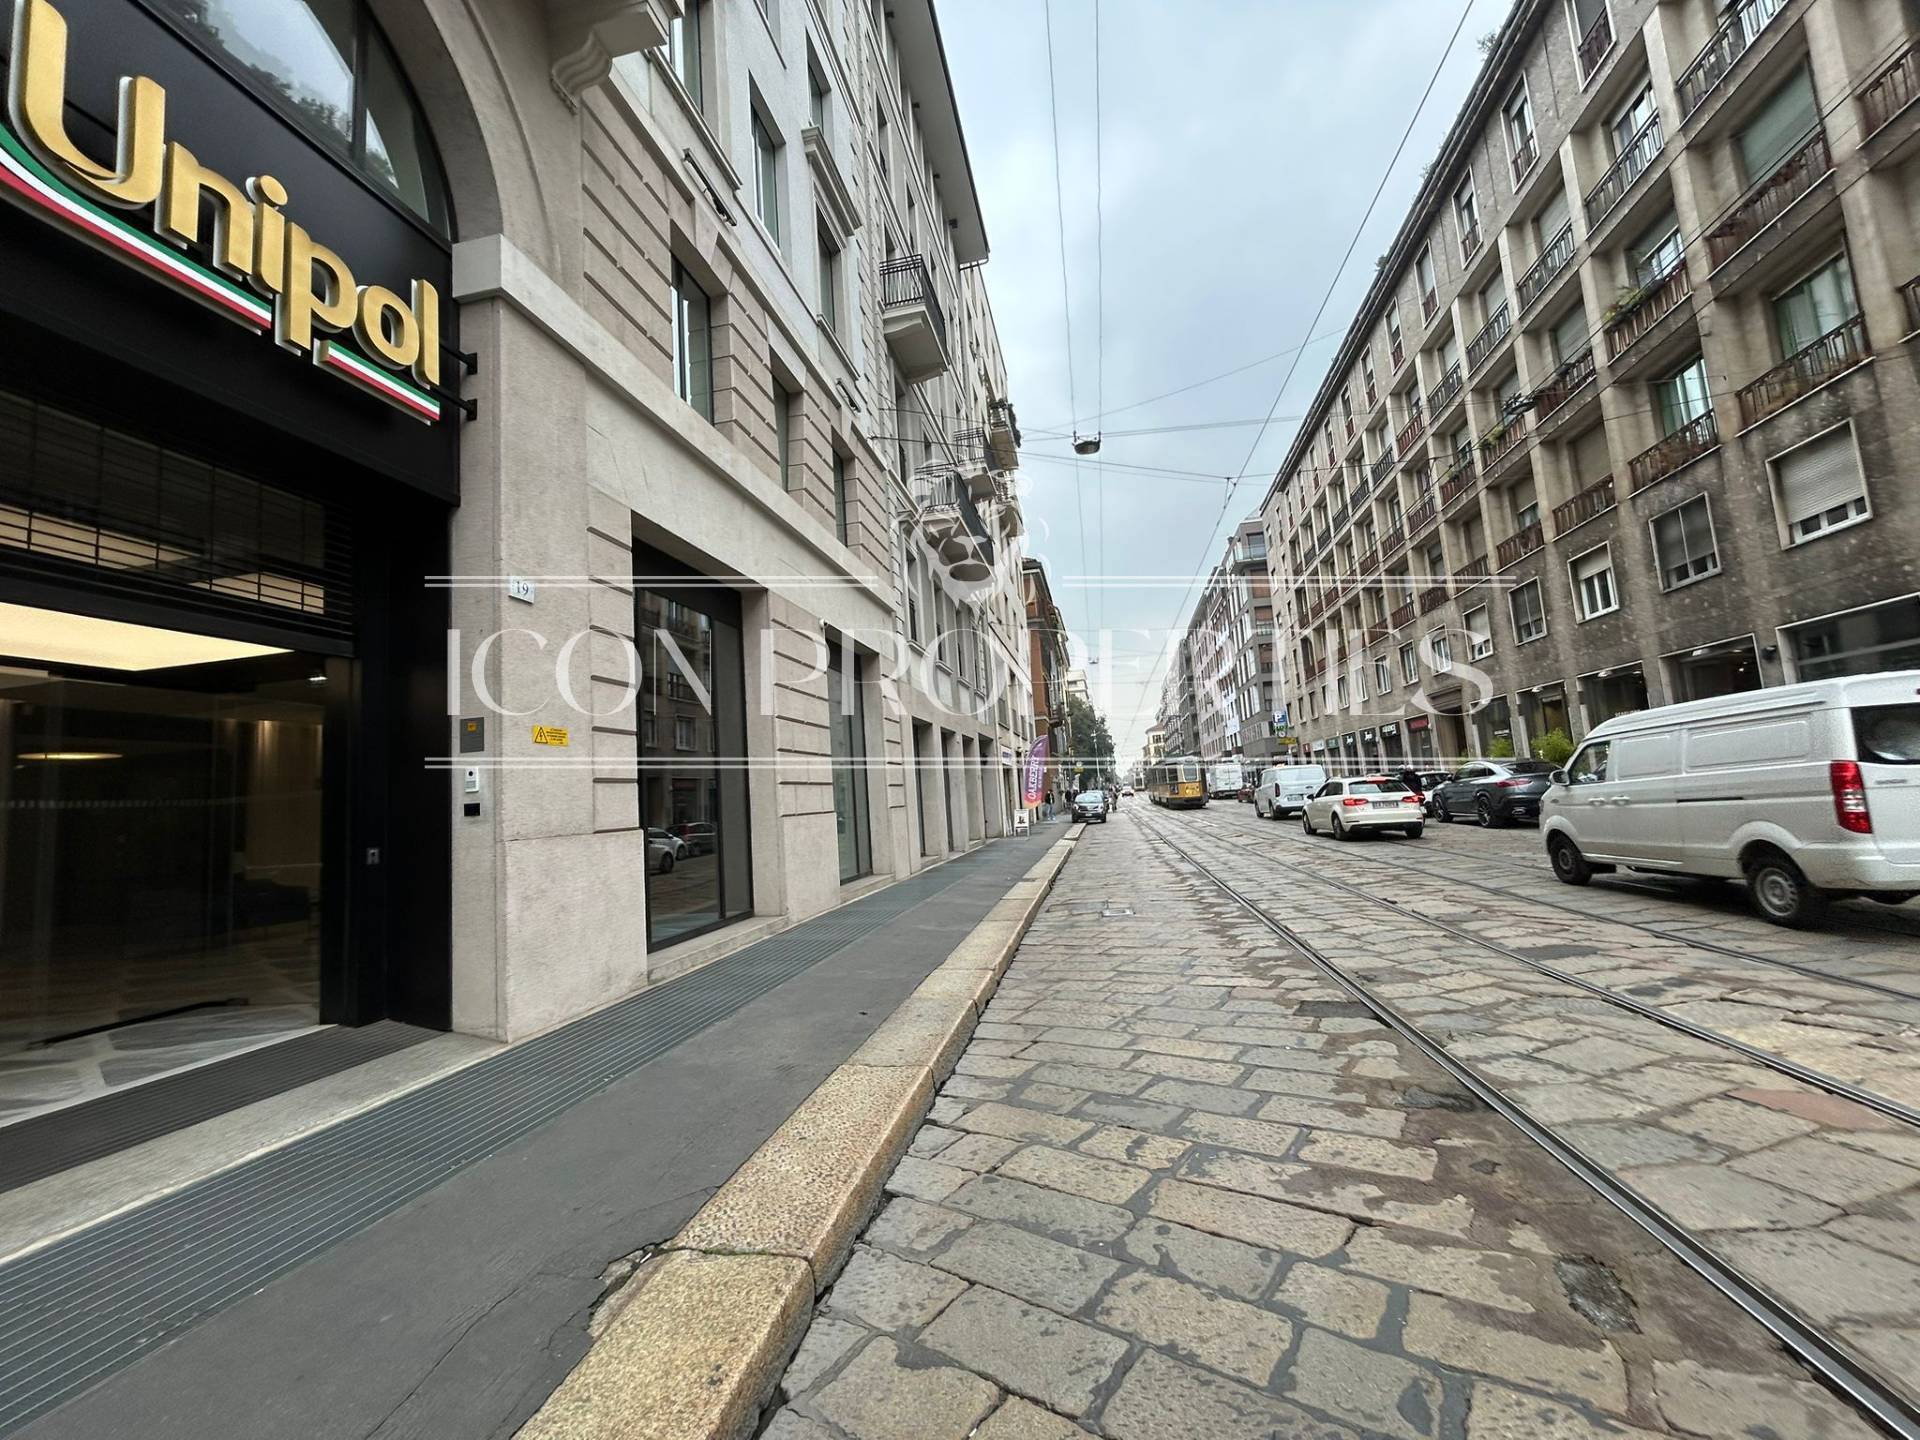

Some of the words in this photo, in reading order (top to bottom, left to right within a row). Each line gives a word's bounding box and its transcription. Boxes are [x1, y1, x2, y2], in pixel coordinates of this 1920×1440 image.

[10, 0, 440, 387] Unipol
[516, 580, 529, 596] 19
[1027, 755, 1039, 800] OAKBERRY
